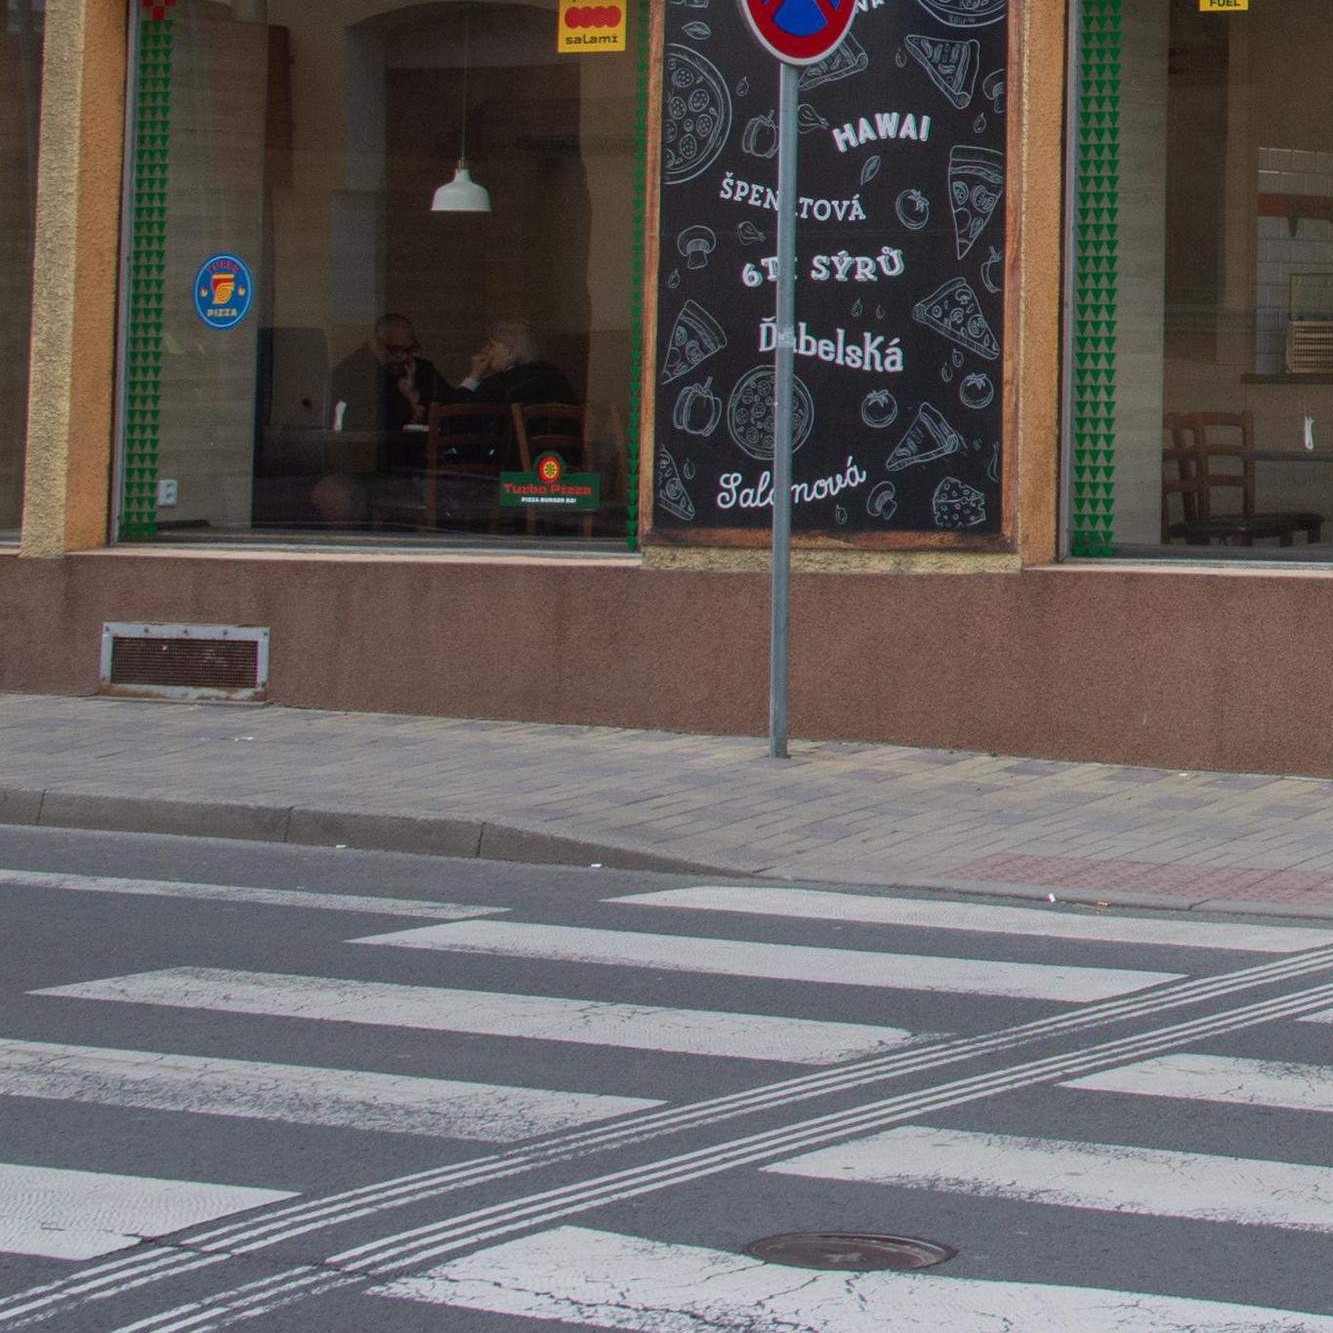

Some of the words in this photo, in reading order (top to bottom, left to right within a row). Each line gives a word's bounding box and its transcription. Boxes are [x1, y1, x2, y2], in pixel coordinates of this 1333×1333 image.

[565, 33, 619, 45] salami
[832, 111, 932, 154] HAWAI
[720, 171, 867, 222] ŠPENTOVÁ
[742, 256, 798, 287] 6T
[810, 245, 905, 283] SÝRŮ
